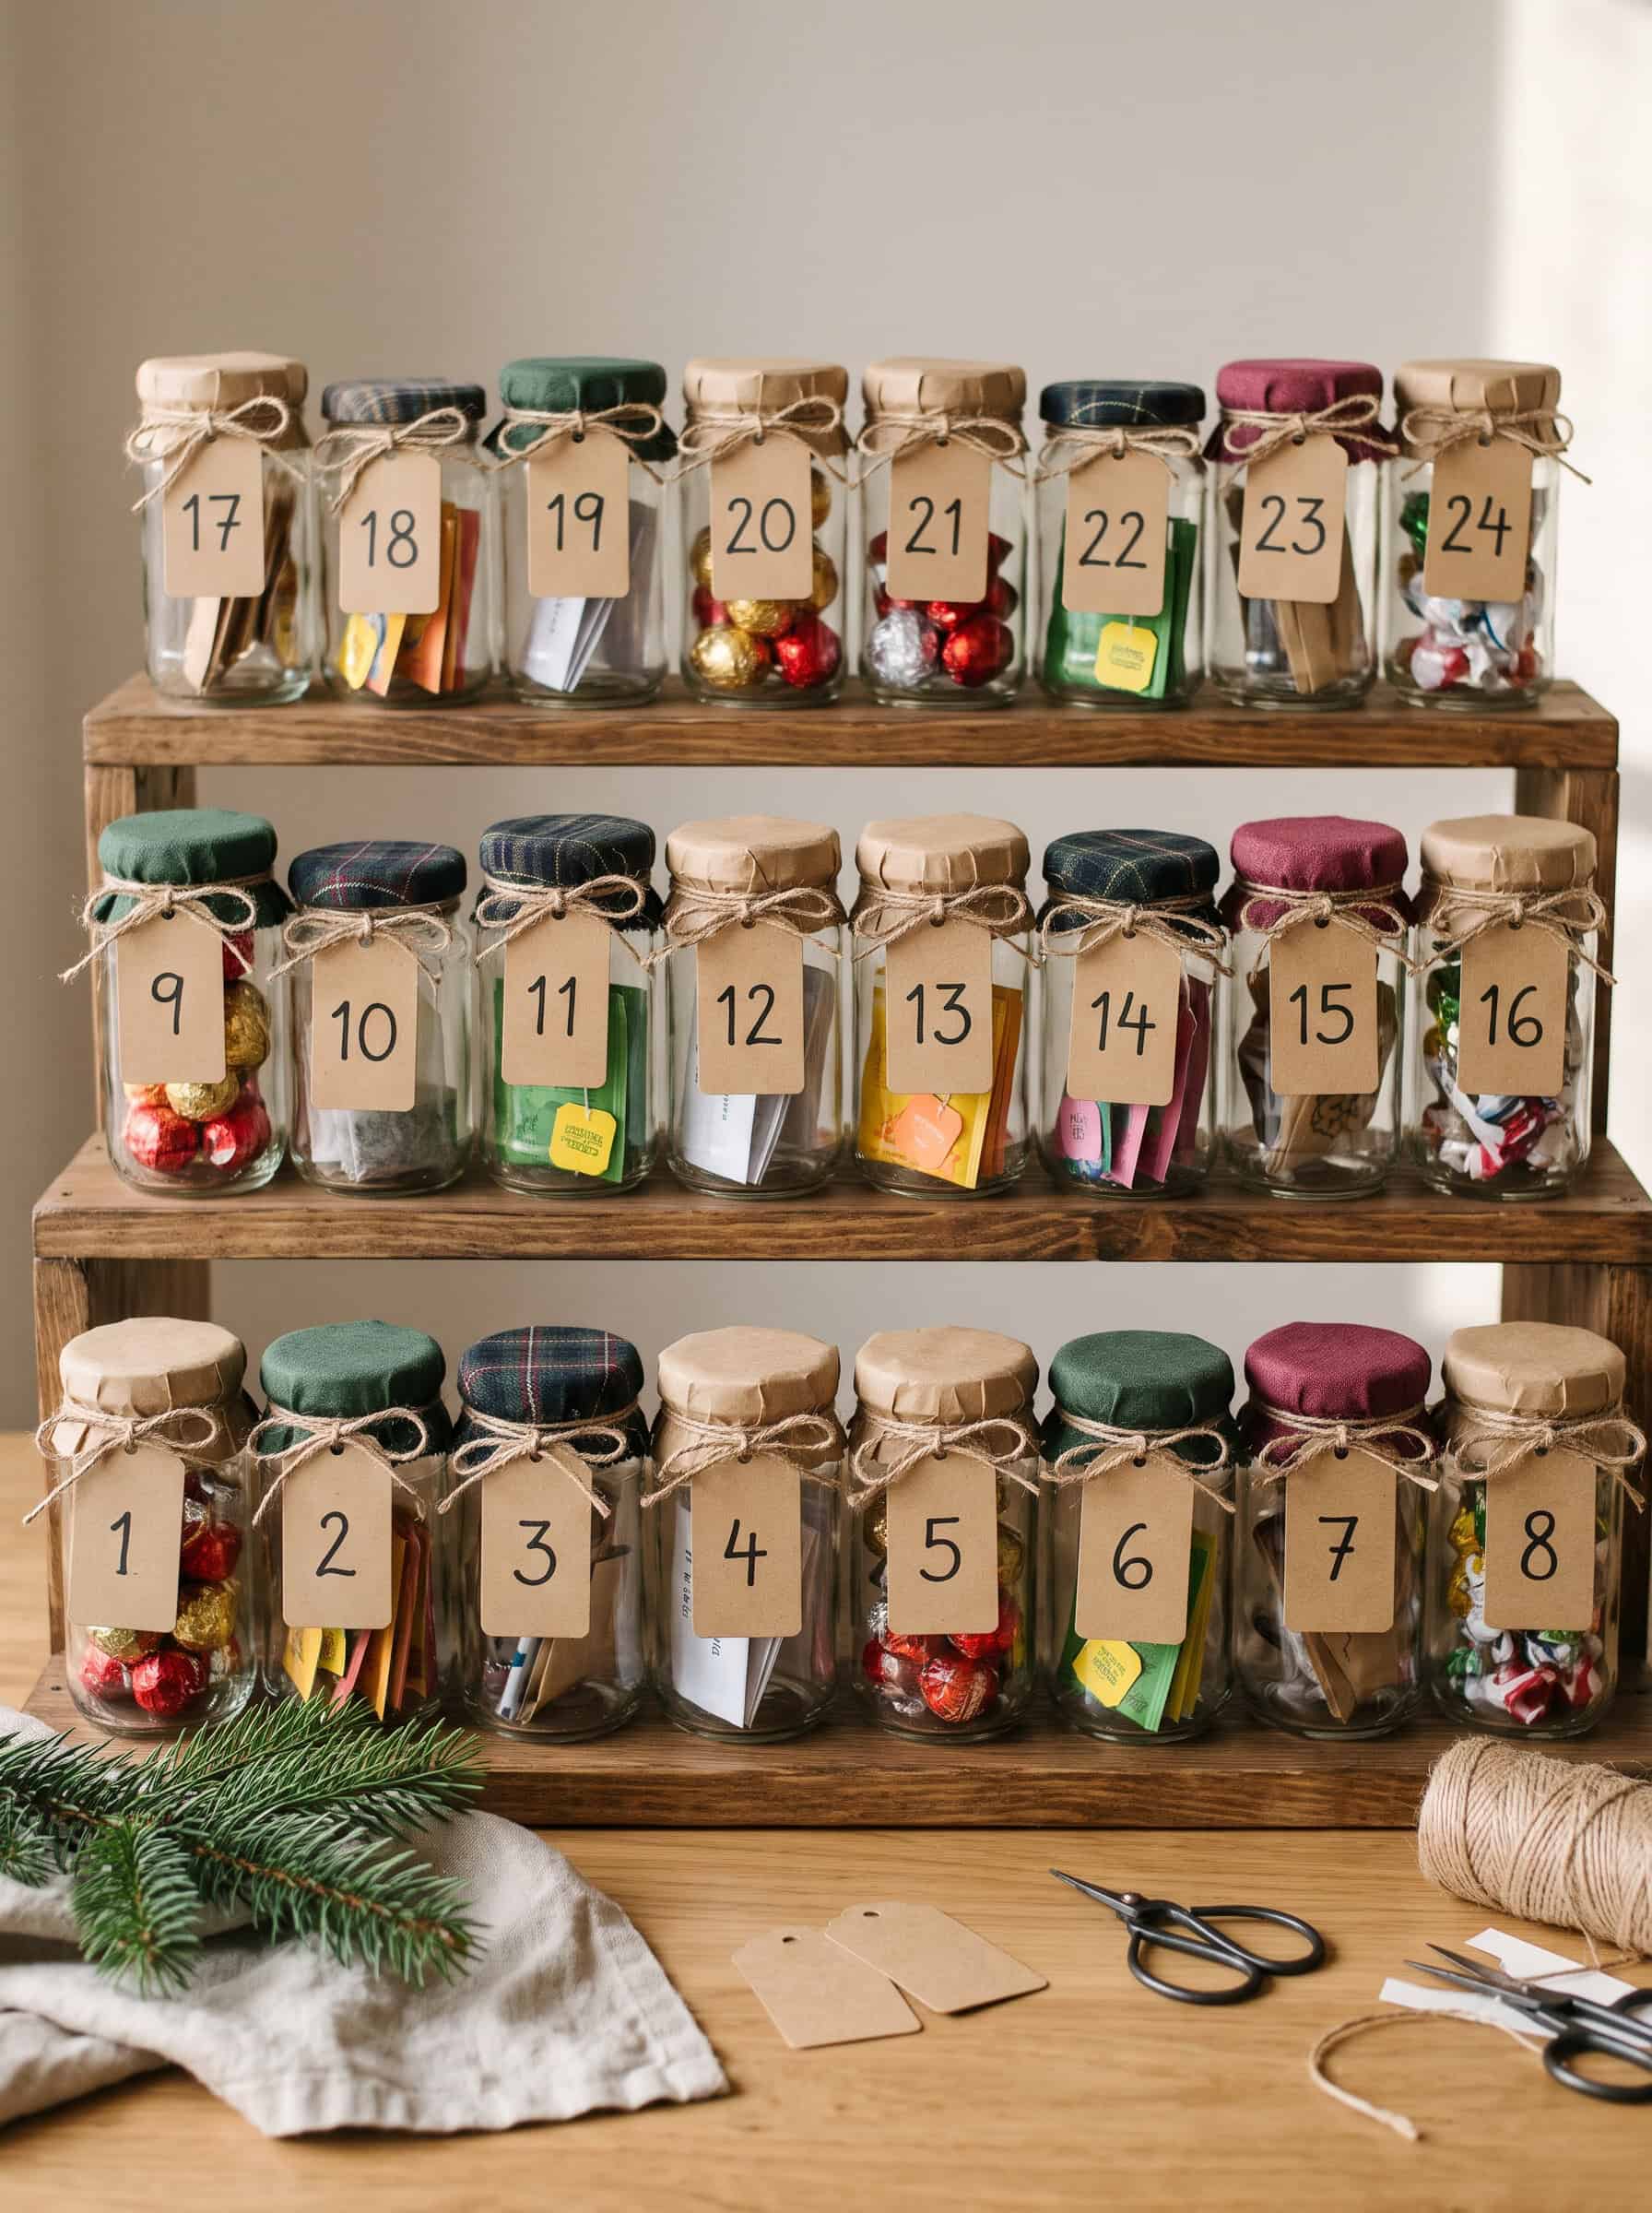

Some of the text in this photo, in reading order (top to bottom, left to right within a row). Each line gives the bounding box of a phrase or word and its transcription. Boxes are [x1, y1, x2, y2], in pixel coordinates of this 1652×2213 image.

[183, 494, 240, 550] 17
[361, 510, 418, 567] 18
[548, 492, 605, 551] 19
[726, 498, 796, 554] 20
[904, 496, 962, 556] 21
[1079, 510, 1147, 569] 22
[1256, 495, 1326, 555] 23
[1441, 494, 1513, 557] 24
[151, 972, 184, 1035] 9
[331, 1000, 397, 1062] 10
[527, 975, 577, 1037] 11
[716, 984, 783, 1047] 12
[906, 983, 972, 1046] 13
[1091, 991, 1156, 1056] 14
[1289, 983, 1354, 1046] 15
[1480, 984, 1543, 1048] 16
[110, 1511, 131, 1576] 1
[315, 1511, 357, 1577] 2
[513, 1520, 557, 1587] 3
[724, 1519, 768, 1587] 4
[919, 1517, 962, 1582] 5
[1113, 1522, 1153, 1591] 6
[1317, 1515, 1359, 1581] 7
[1520, 1509, 1558, 1581] 8
